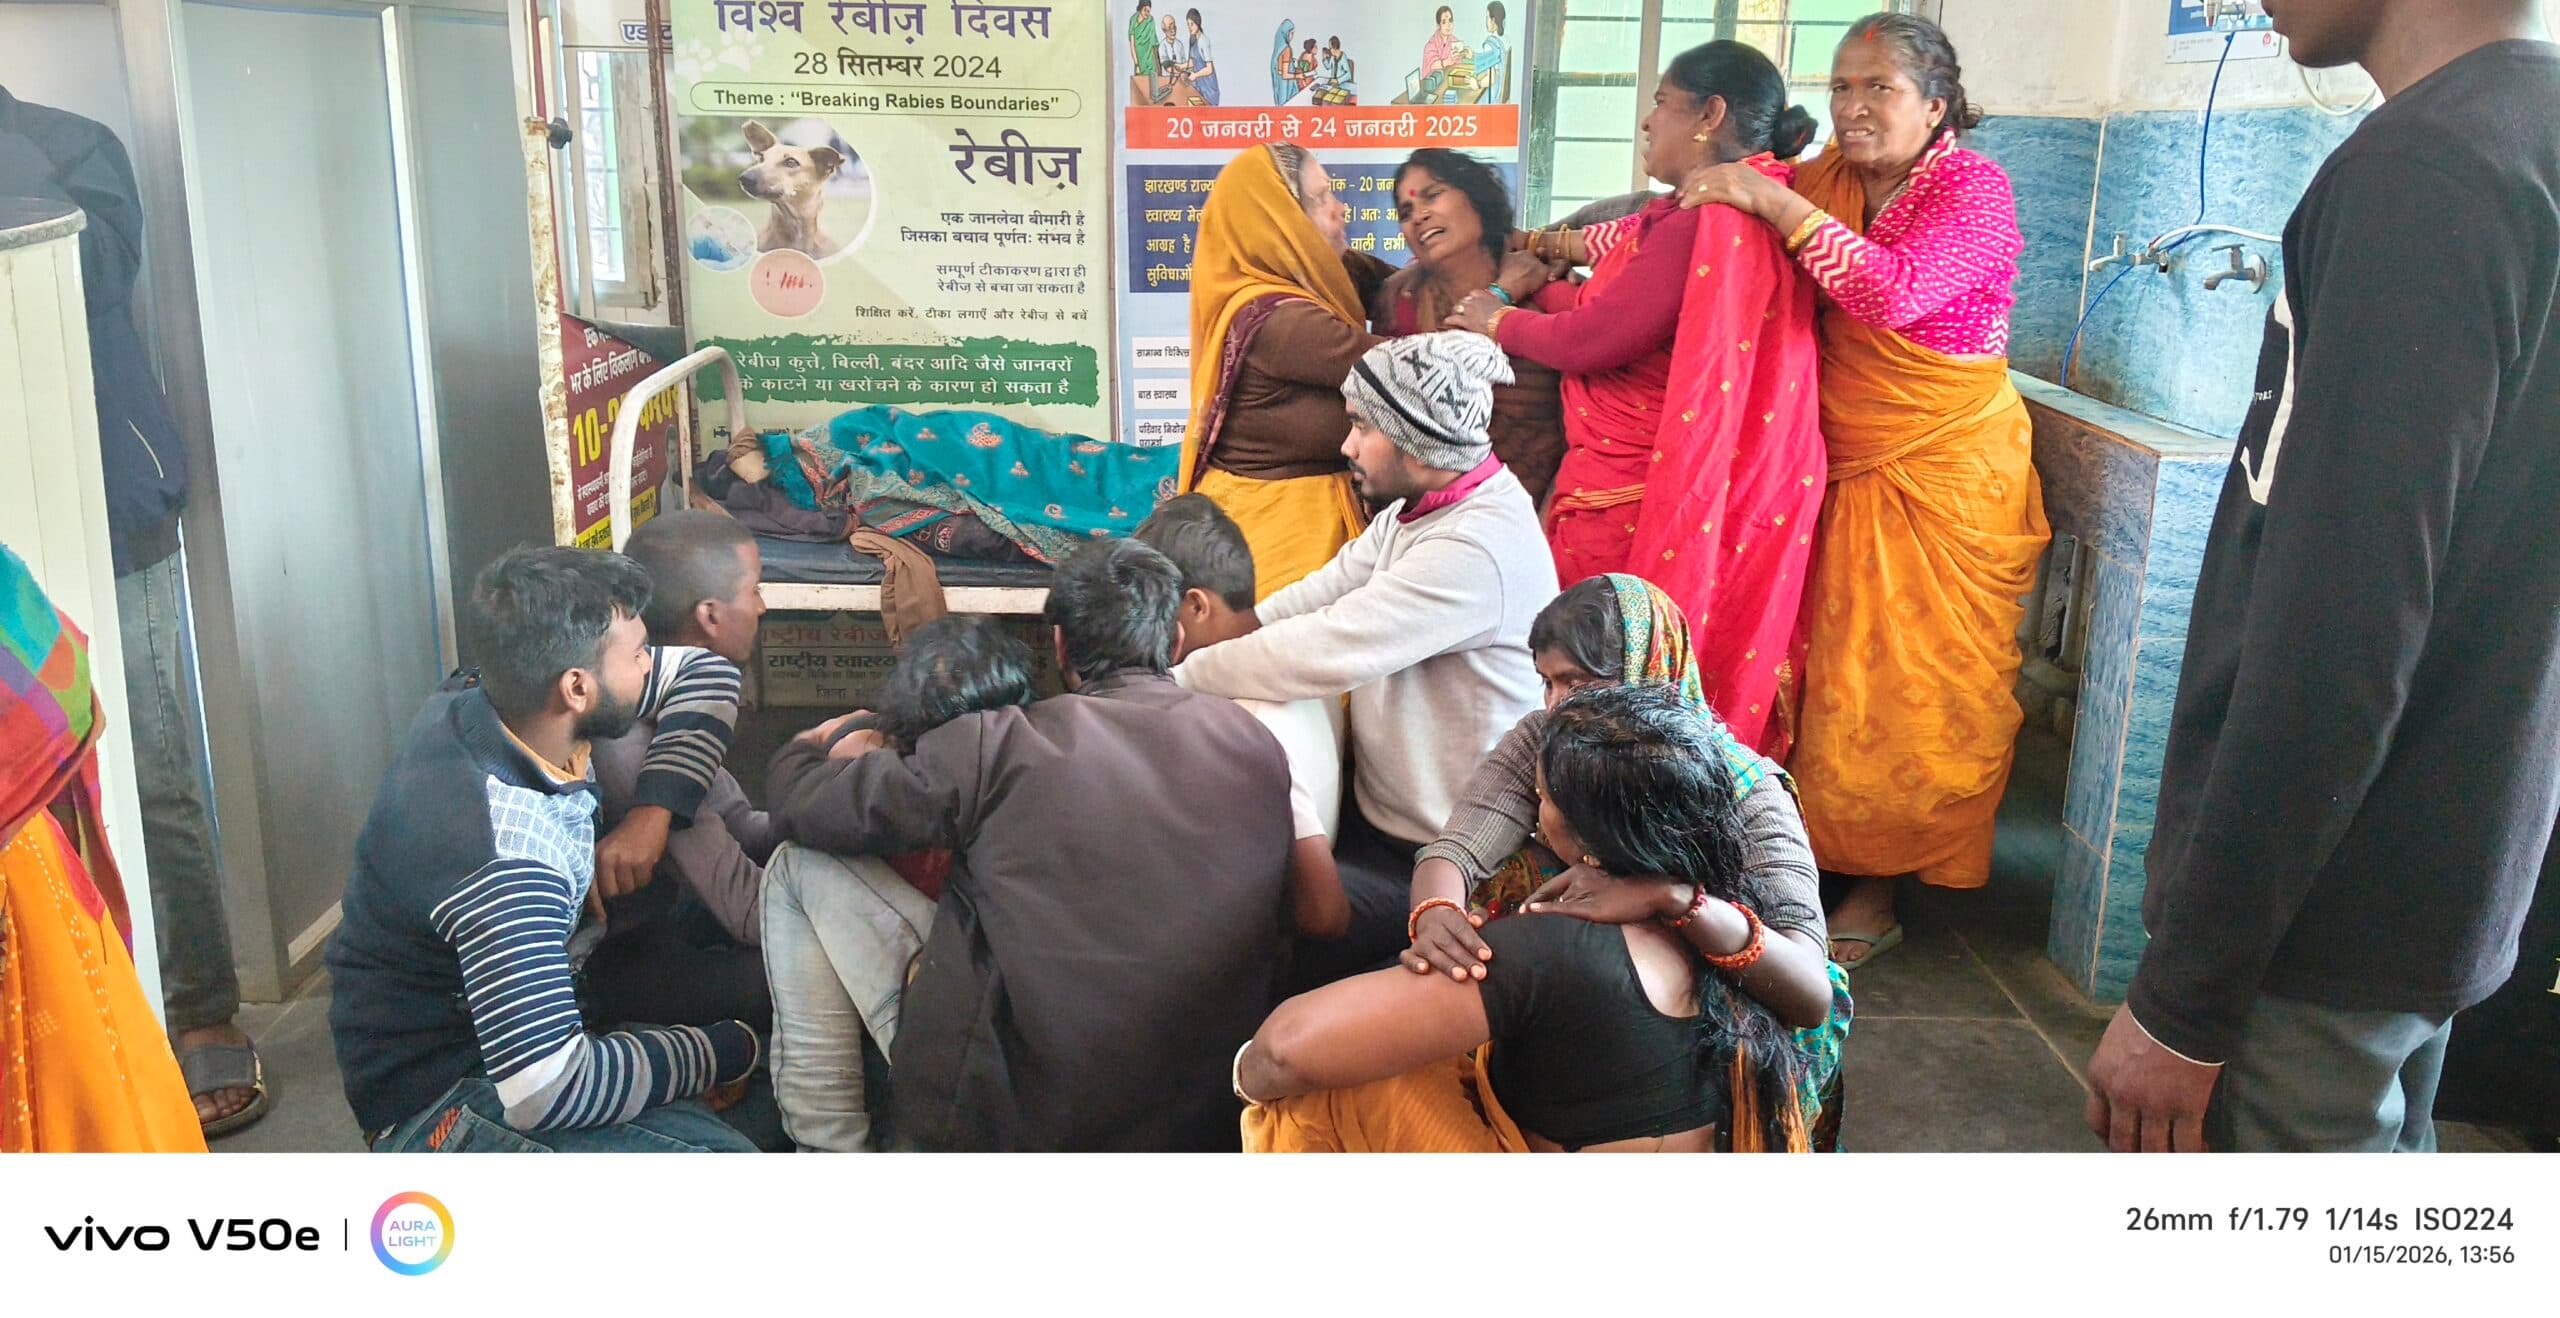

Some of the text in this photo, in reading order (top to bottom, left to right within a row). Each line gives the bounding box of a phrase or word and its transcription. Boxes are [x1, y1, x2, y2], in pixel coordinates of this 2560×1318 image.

[794, 47, 1001, 78] 28 सितम्बर 2024
[714, 90, 774, 106] Theme
[885, 94, 945, 110] Rabies
[1167, 113, 1478, 139] 20 जनवरी से 24 जनवरी 2025
[949, 128, 1082, 189] रेबीज़
[1144, 179, 1188, 193] झारखण्ड
[1359, 176, 1373, 192] 20
[941, 210, 1085, 226] एक जानलेवा बीमारी है
[901, 226, 947, 243] जिसका
[953, 231, 989, 244] बचाव
[1038, 229, 1071, 245] संभव
[1076, 229, 1085, 245] है
[1146, 239, 1175, 253] आग्रह
[1182, 233, 1191, 253] है
[1351, 232, 1376, 251] वाली
[936, 262, 1086, 278] सम्पूर्ण टीकाकरण द्वारा ही
[975, 279, 986, 293] से
[990, 282, 1014, 293] बचा
[1017, 283, 1033, 293] जा
[1037, 283, 1073, 294] सकता
[1077, 280, 1085, 294] है
[924, 307, 951, 319] टीका
[993, 307, 1014, 320] और
[1055, 308, 1065, 320] से
[890, 354, 924, 371] बंदर
[930, 353, 969, 372] आदि
[974, 352, 1006, 372] जैसे
[1011, 354, 1073, 373] जानवरों
[760, 374, 807, 391] काटने
[813, 379, 832, 391] या
[907, 375, 922, 393] के
[929, 379, 975, 393] कारण
[981, 376, 998, 395] हो
[1004, 380, 1053, 395] सकता
[1058, 377, 1070, 396] है
